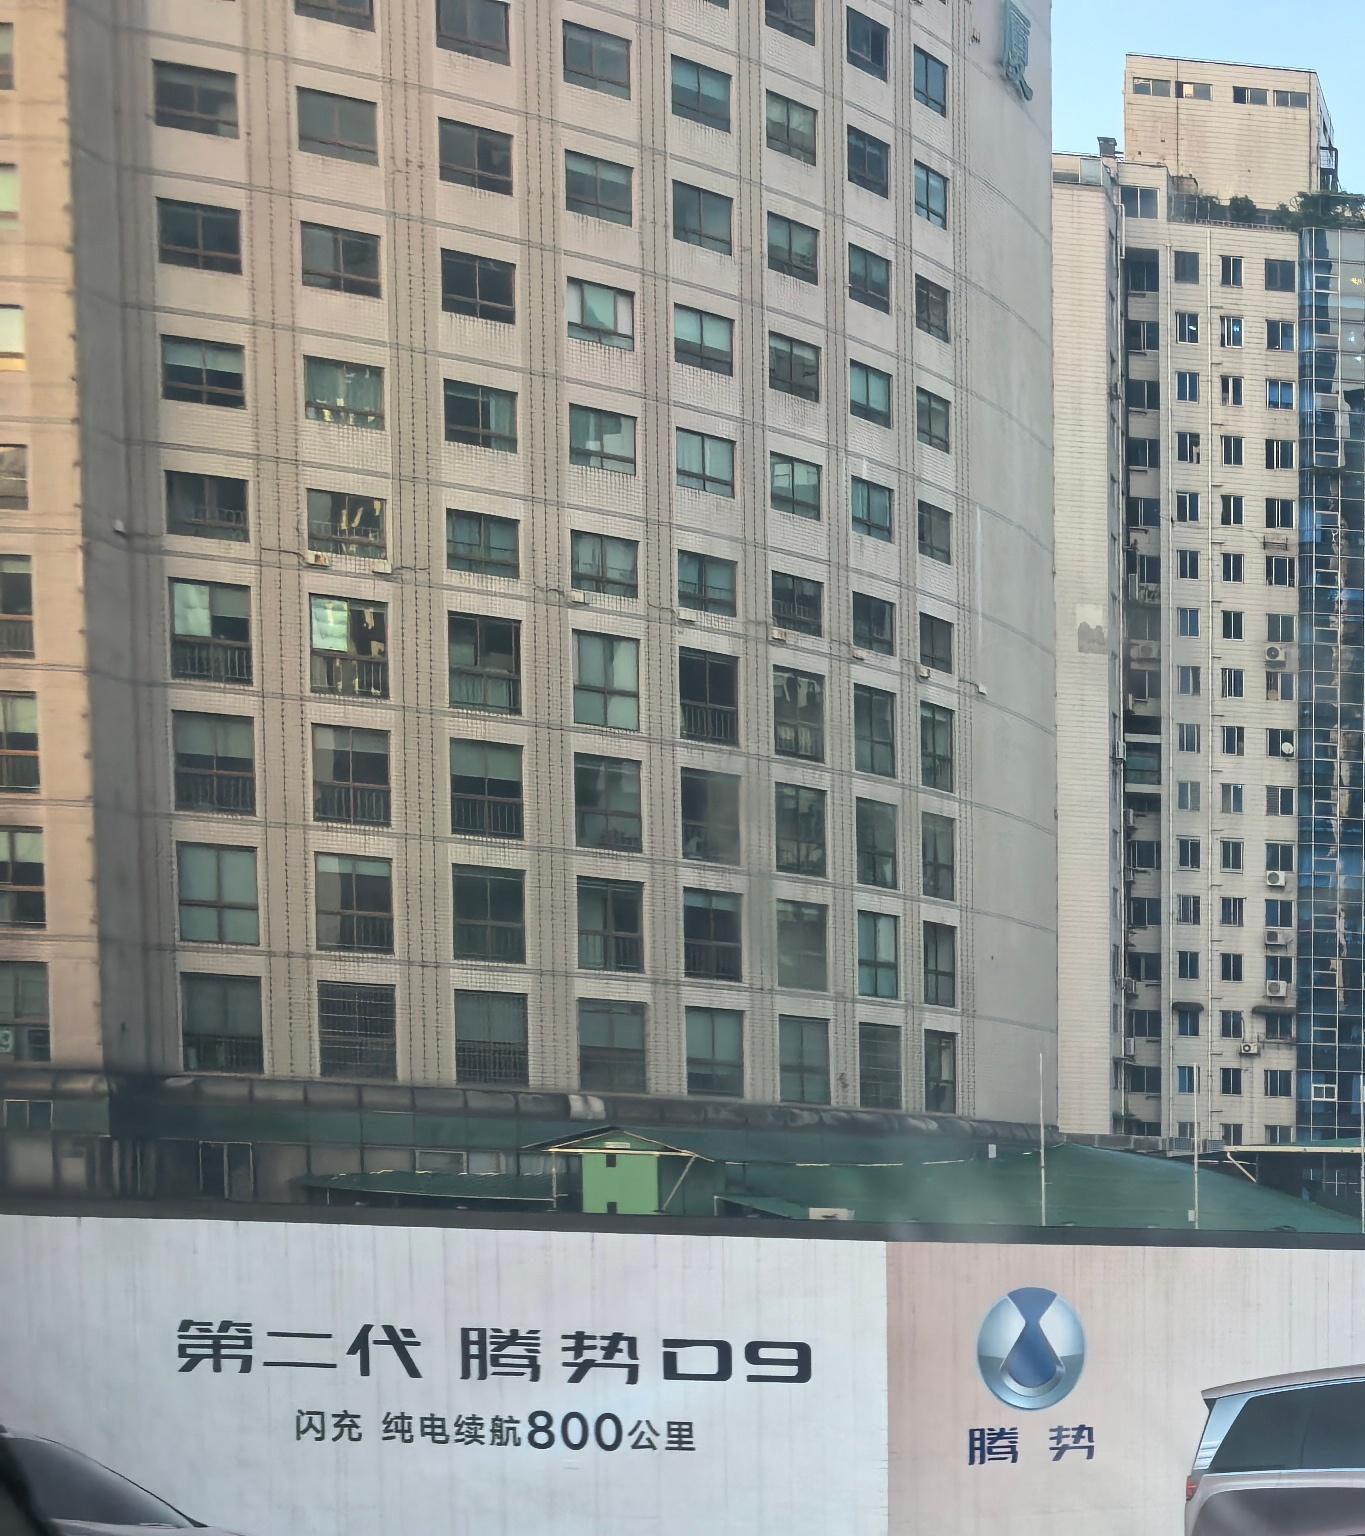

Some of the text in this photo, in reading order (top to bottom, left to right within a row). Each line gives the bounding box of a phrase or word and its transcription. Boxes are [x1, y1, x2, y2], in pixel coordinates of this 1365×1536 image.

[177, 1319, 814, 1386] 第二代 腾势D9
[294, 1408, 697, 1452] 闪充 纯电续航800公里
[967, 1424, 1096, 1466] 腾势
